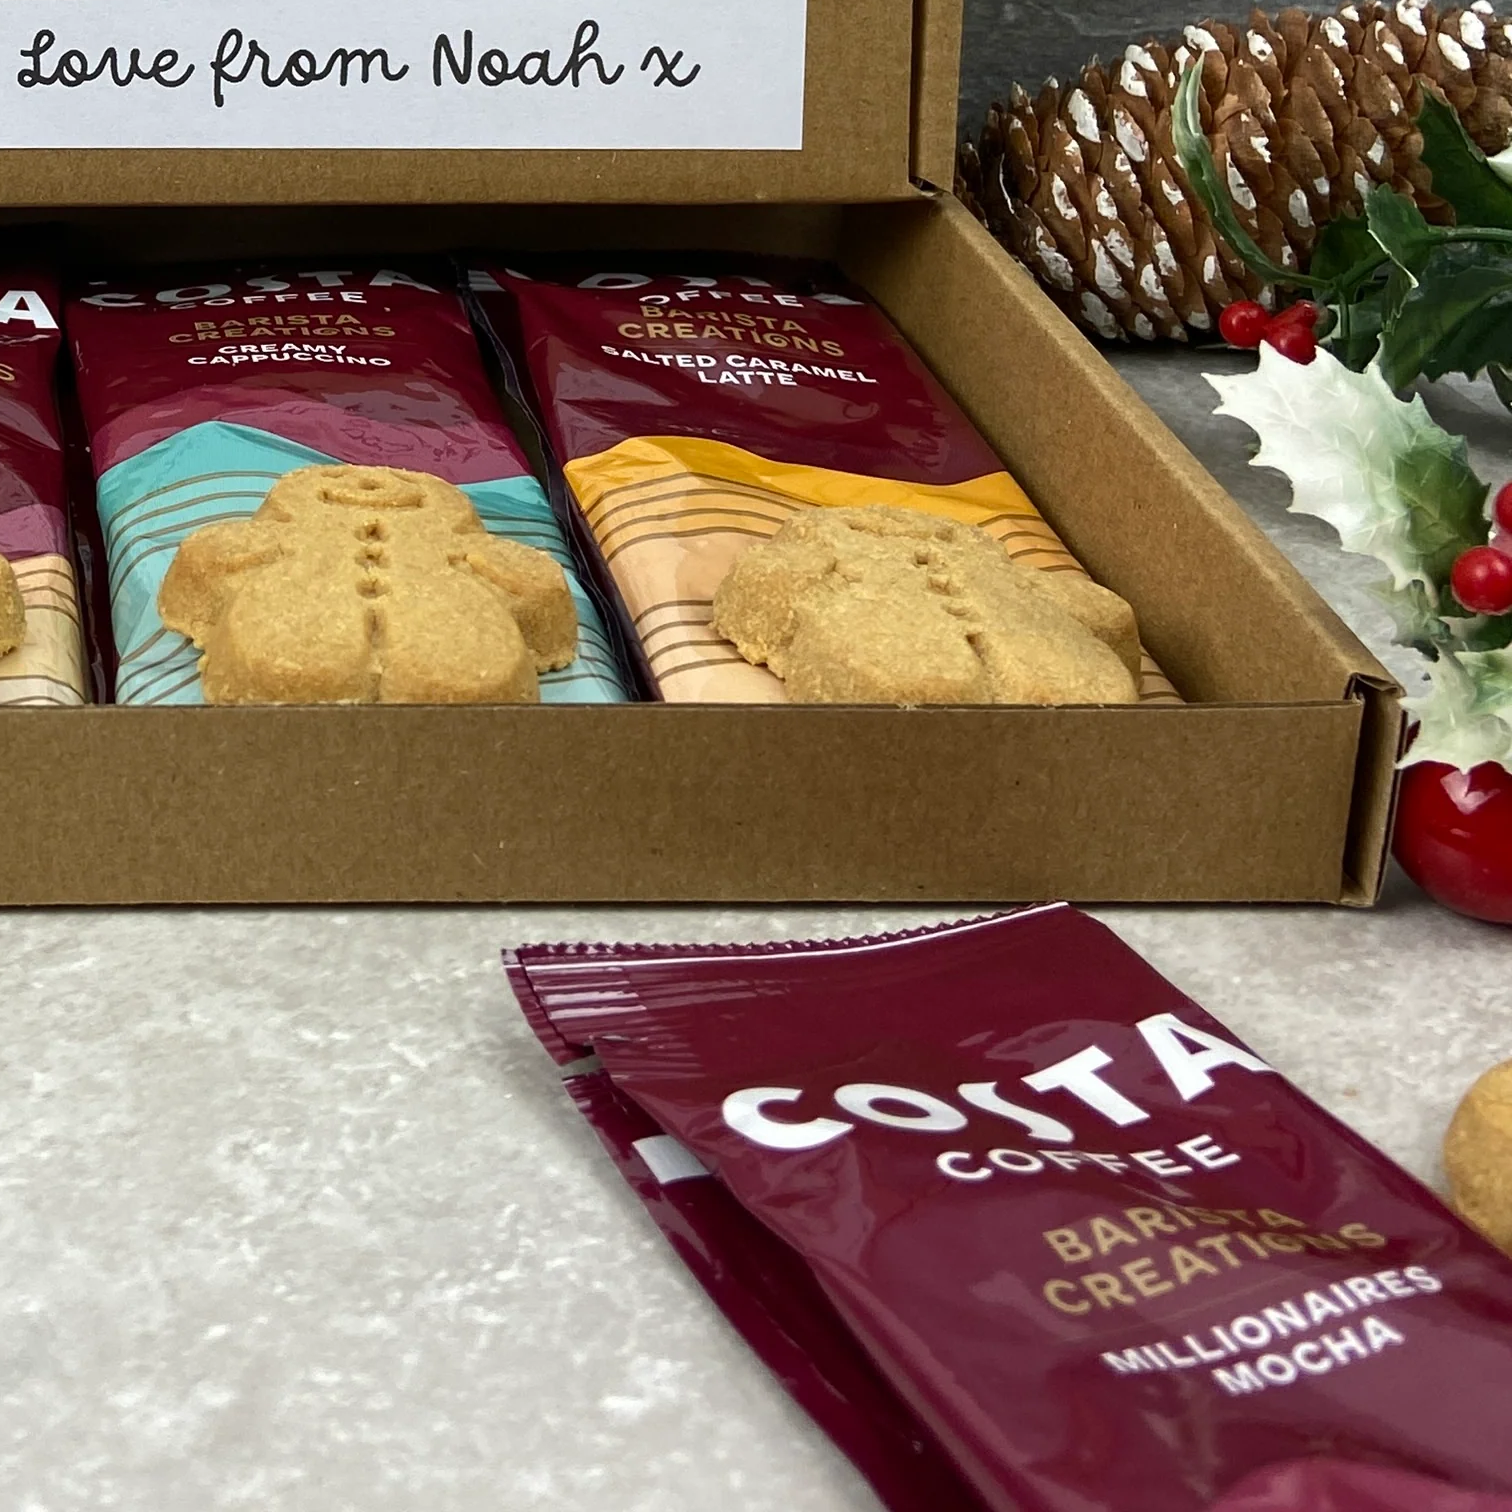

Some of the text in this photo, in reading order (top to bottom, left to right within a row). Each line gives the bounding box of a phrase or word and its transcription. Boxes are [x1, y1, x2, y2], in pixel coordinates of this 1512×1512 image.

[16, 28, 196, 88] Love
[208, 27, 410, 108] from
[431, 18, 625, 88] Noah
[639, 45, 701, 88] x
[80, 269, 441, 307] COSTA
[169, 290, 368, 310] COFFEE
[168, 325, 396, 344] CREATIONS
[193, 314, 361, 332] BARISTA
[640, 304, 808, 334] BARISTA
[217, 343, 347, 356] CREAMY
[616, 322, 846, 357] CREATIONS
[187, 353, 392, 366] CAPPUCCINO
[600, 345, 879, 384] SALTED CARAMEL
[698, 370, 798, 387] LATTE
[721, 1012, 1276, 1151] COSTA
[935, 1134, 1242, 1183] COFFEE
[1042, 1205, 1303, 1265] BARISTA
[1042, 1221, 1386, 1316] CREATIONS
[1101, 1265, 1444, 1376] MILLIONAIRES
[1214, 1316, 1405, 1396] MOCHA
